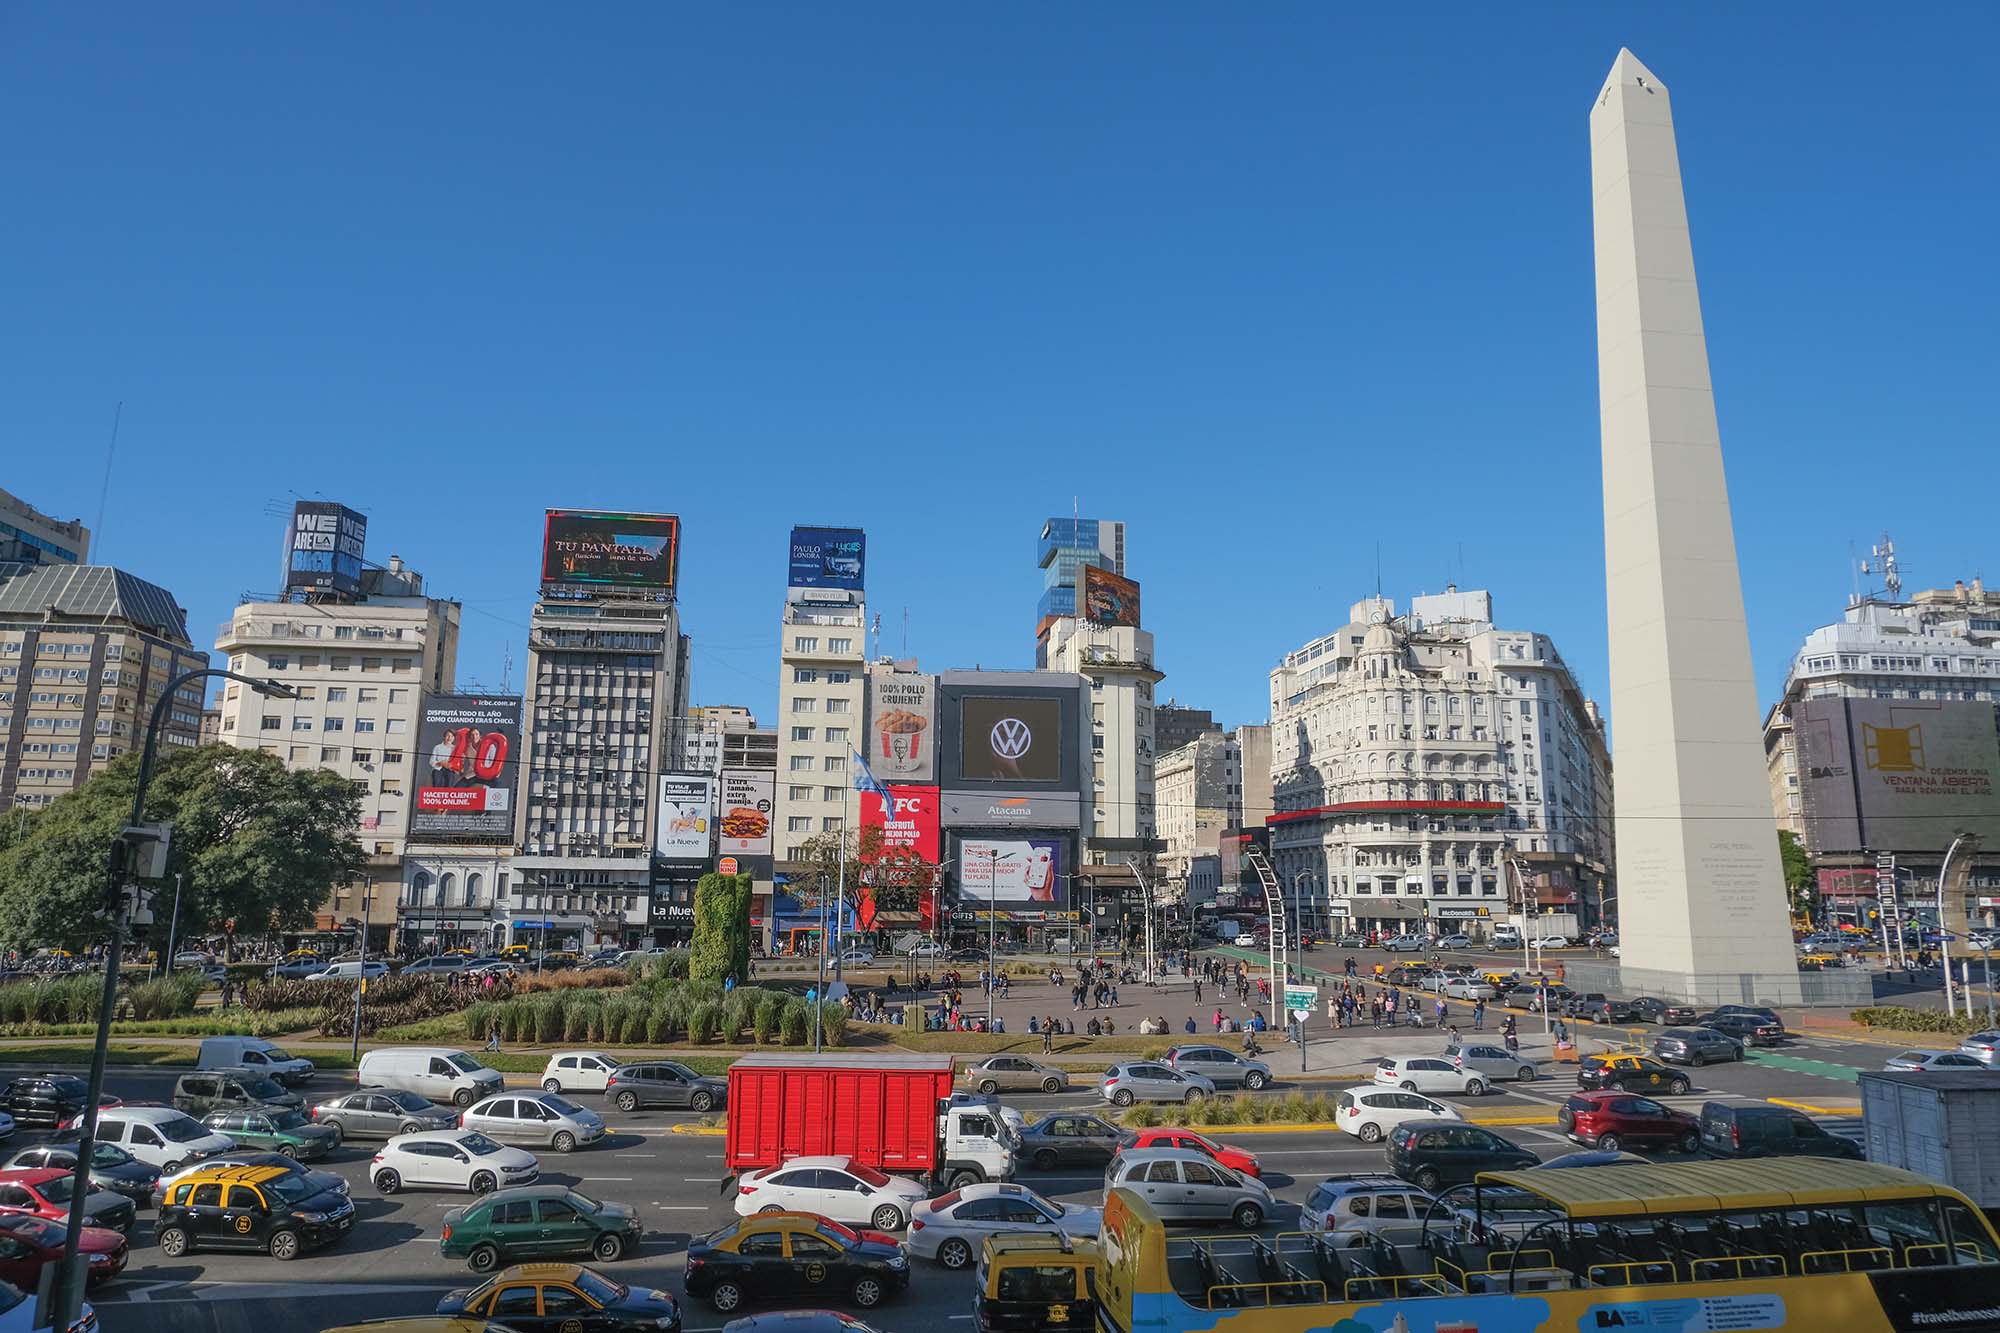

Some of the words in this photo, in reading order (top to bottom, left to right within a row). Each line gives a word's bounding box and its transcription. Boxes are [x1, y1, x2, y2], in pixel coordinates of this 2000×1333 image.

[297, 514, 337, 532] WE
[342, 516, 365, 541] WE
[294, 532, 313, 550] ARE
[555, 541, 577, 552] TU
[793, 545, 820, 553] PAULO
[880, 685, 900, 694] 100%
[902, 685, 925, 694] POLLO
[882, 695, 924, 705] CRUJIENTE
[1882, 775, 1937, 786] VENTANA
[1942, 776, 1990, 787] ABIERTA
[987, 806, 1031, 815] Atacama
[884, 820, 915, 829] DISFRUTÁ
[653, 906, 666, 916] La
[1596, 1310, 1624, 1328] BA
